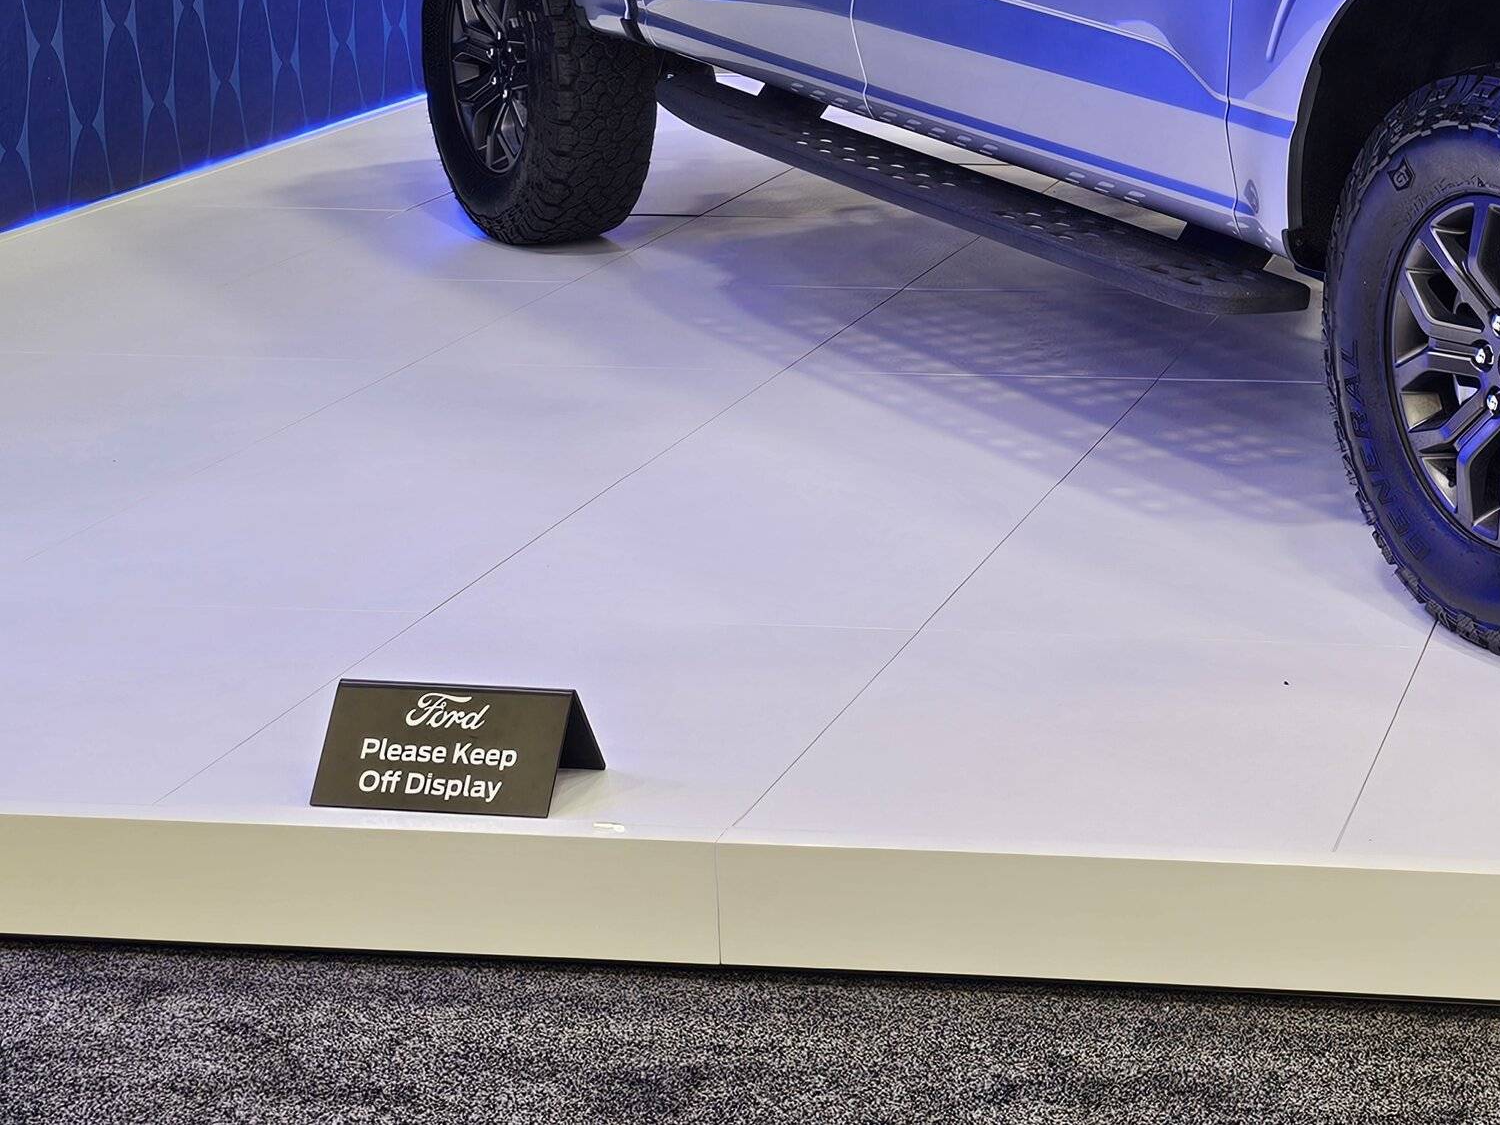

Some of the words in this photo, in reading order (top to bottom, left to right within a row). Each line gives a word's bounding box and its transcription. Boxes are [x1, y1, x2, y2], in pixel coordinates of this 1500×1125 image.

[405, 692, 490, 730] Ford
[360, 738, 447, 764] Please
[452, 742, 518, 771] Keep
[358, 770, 402, 794] Off
[404, 772, 502, 803] Display
